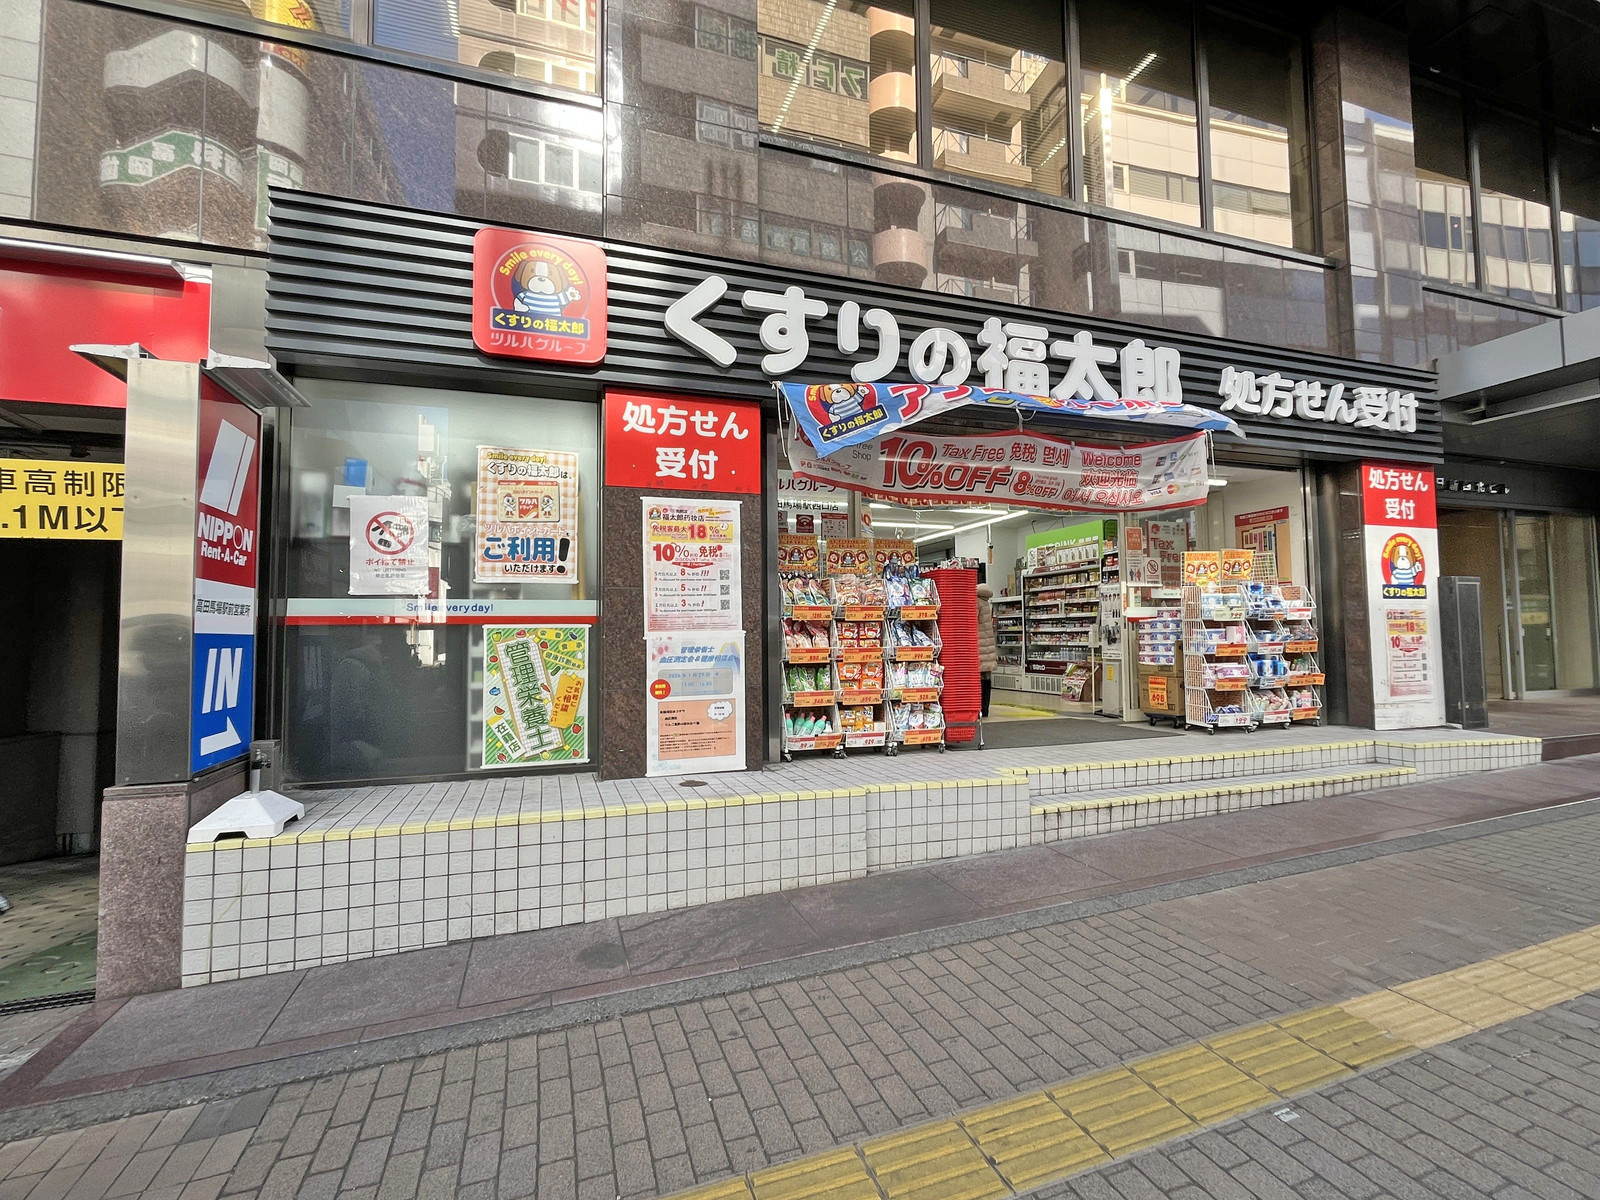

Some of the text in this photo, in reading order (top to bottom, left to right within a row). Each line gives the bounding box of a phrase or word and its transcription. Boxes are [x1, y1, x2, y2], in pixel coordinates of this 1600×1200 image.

[500, 249, 583, 285] Smile every day!
[494, 312, 585, 335] くすりの福太郎
[664, 275, 1182, 404] くすりの福太郎
[1219, 365, 1419, 434] 処方せん受付
[622, 401, 749, 440] 処方せん
[822, 408, 883, 438] くすりの福太郎
[655, 447, 718, 480] 受付
[852, 450, 872, 462] Shop
[941, 443, 1005, 462] Tax Free
[1011, 441, 1037, 462] 免税
[1042, 445, 1070, 468] 면세
[1082, 451, 1142, 468] Welcome
[0, 468, 125, 497] 車高制限
[1368, 467, 1429, 492] 処方せん
[2, 505, 124, 533] .1M以
[1385, 498, 1416, 520] 受付
[197, 511, 254, 553] NIPPON
[1150, 537, 1175, 550] Tax
[1160, 551, 1180, 563] Fre
[439, 603, 469, 613] very
[201, 647, 243, 714] IN
[505, 641, 554, 751] 管理栄養士
